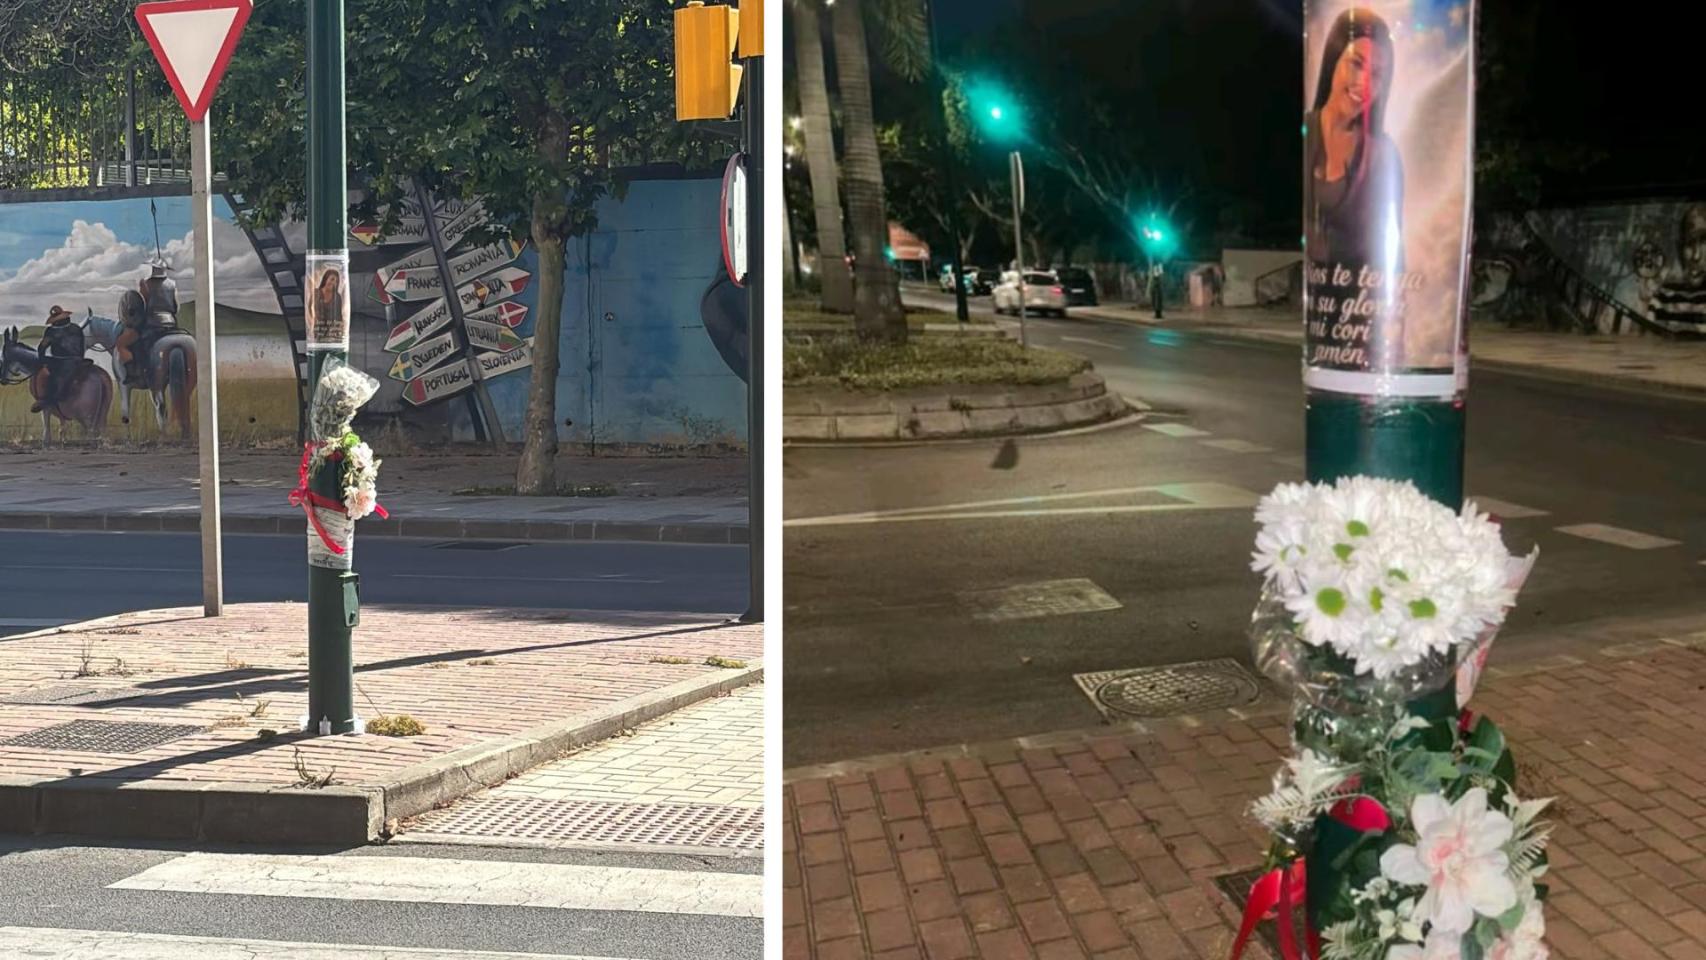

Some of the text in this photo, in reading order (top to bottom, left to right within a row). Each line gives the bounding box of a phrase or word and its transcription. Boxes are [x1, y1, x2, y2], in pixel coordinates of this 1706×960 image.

[453, 248, 505, 275] ROMANIA
[1307, 261, 1328, 285] ios
[1332, 261, 1352, 287] te
[407, 276, 441, 289] FRANCE
[1317, 295, 1336, 313] su
[414, 303, 447, 335] HUNGARY
[1331, 320, 1374, 341] cori
[412, 339, 452, 368] SWEDEN
[481, 349, 527, 370] SLOVENIA
[425, 366, 470, 392] PORTUGAL
